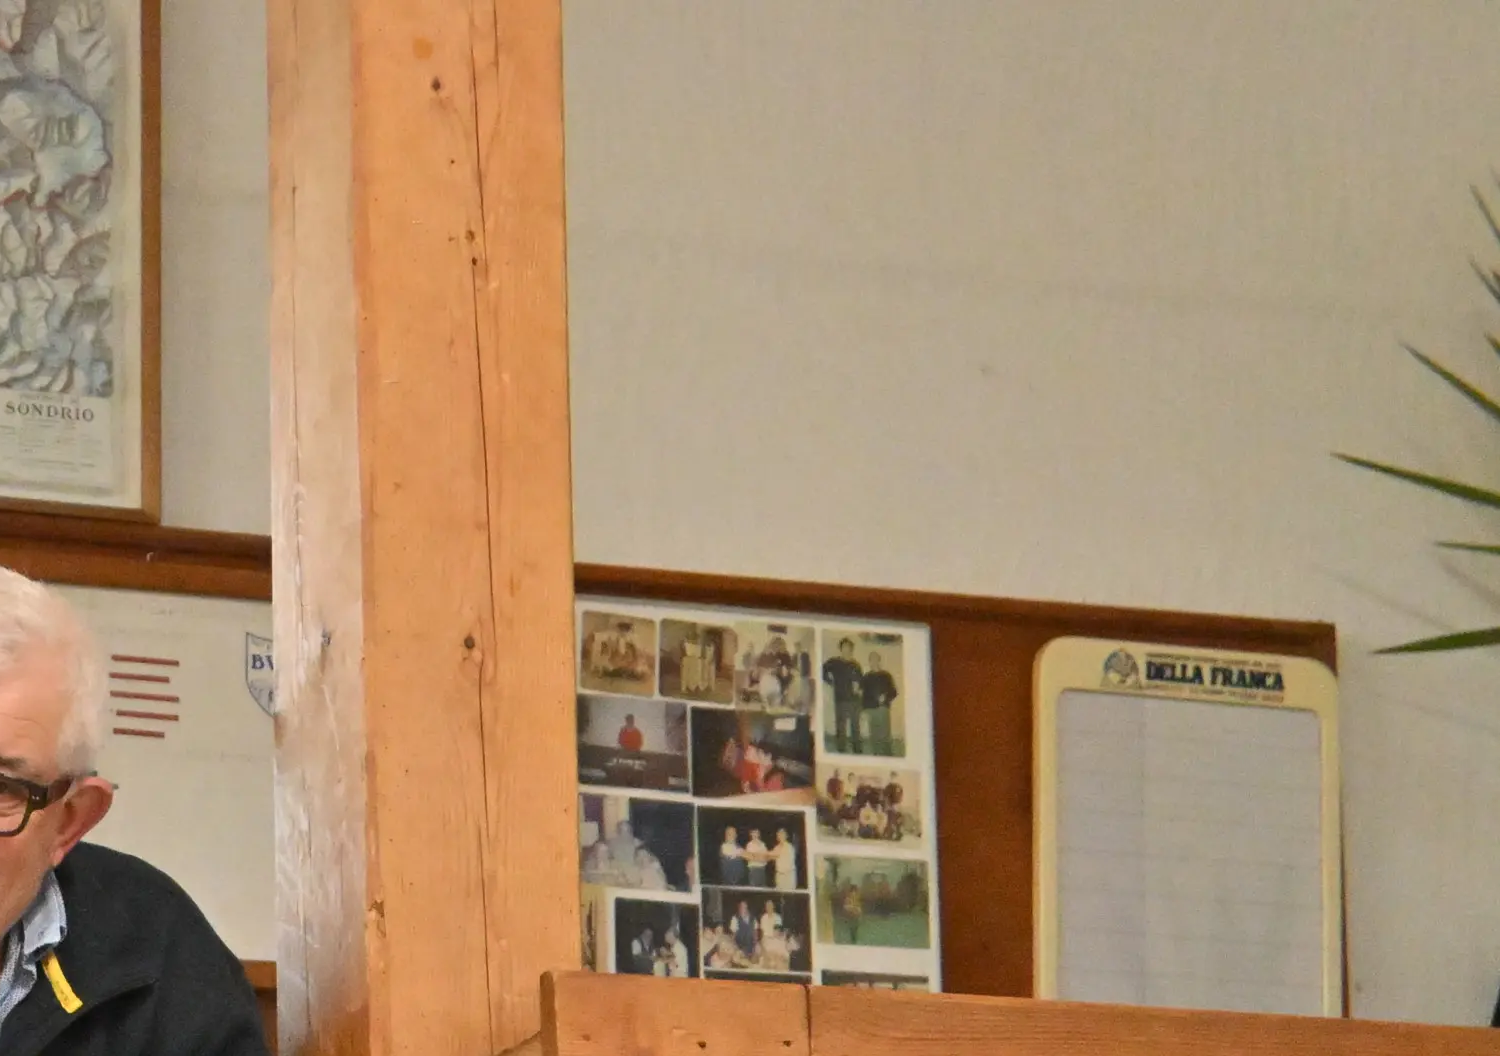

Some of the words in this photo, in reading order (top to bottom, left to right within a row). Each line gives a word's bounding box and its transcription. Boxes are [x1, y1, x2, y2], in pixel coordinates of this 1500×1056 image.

[4, 400, 95, 422] SONDRIO
[1145, 661, 1204, 685] DELLA
[1210, 666, 1285, 691] FRANCA
